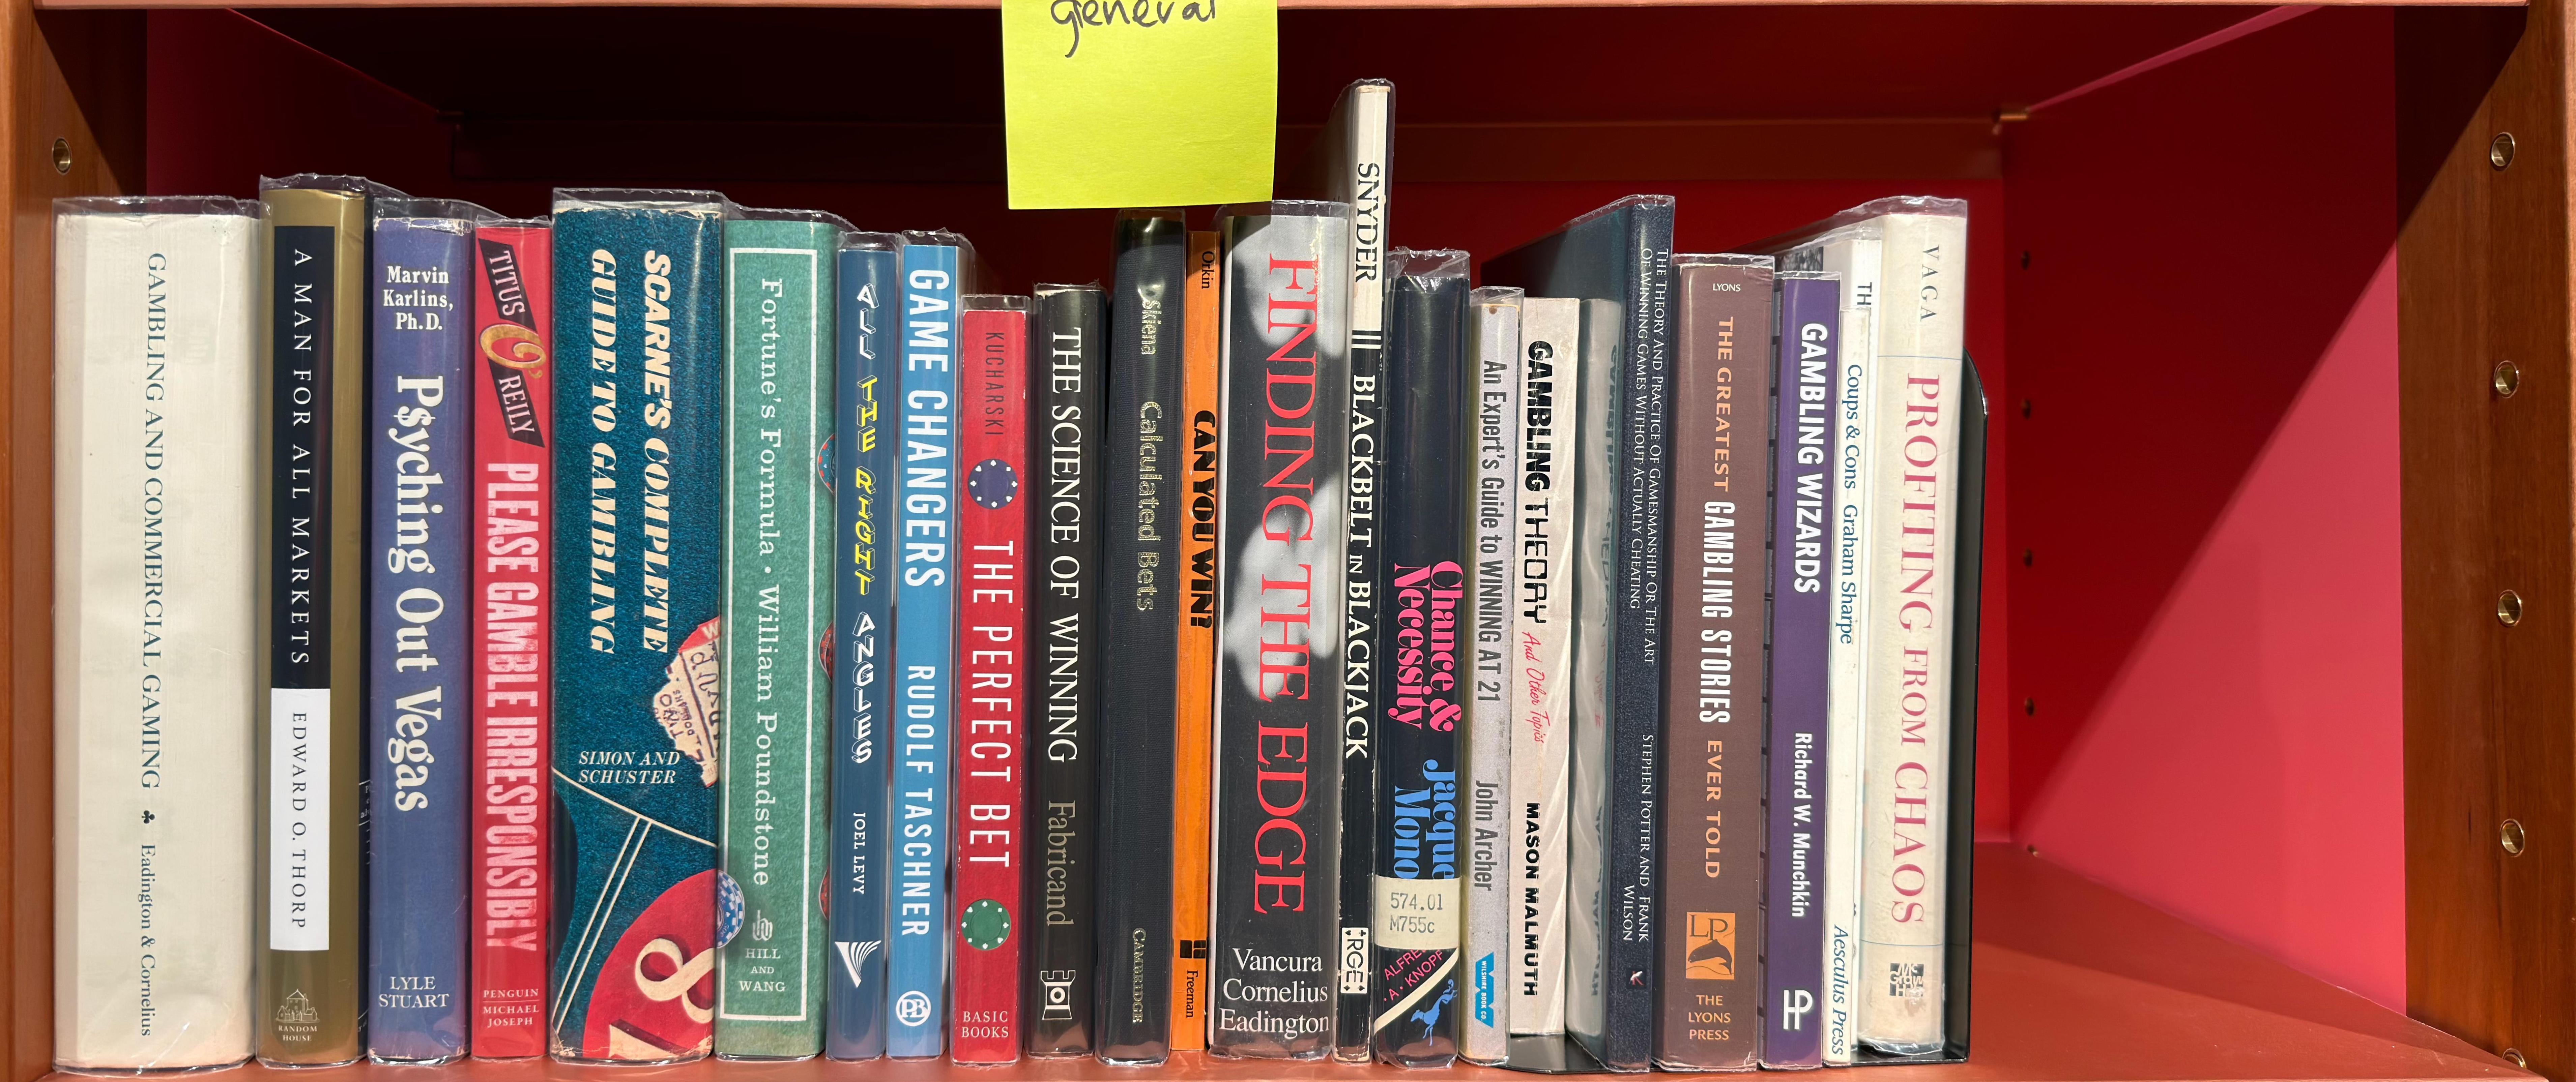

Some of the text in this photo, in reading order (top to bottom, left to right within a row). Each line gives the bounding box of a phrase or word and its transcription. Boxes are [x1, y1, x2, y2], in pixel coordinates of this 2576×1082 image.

[387, 266, 449, 283] Marvin
[1202, 250, 1214, 290] Orkin
[1355, 162, 1380, 283] SNYDER
[382, 290, 454, 311] Karlins,
[396, 313, 442, 330] Ph.D.
[489, 250, 525, 316] TITUS
[1141, 300, 1162, 355] Skiena
[1712, 283, 1741, 292] LYONS
[1920, 244, 1940, 322] VAGA
[905, 270, 950, 586] GAME CHANGERS
[984, 332, 1004, 436] KUCHARSKI
[1630, 248, 1652, 609] OF WINNING GAMES WITHOUT ACTUALLY CHEATING
[1842, 364, 1863, 489] Coups Cons
[291, 248, 312, 663] A MAN FOR ALL MARKETS
[590, 248, 616, 654] GUIDE TO GAMBLING
[643, 250, 672, 652] SCARNE'S COMPLETE
[1136, 402, 1162, 611] Calculated Bets
[1523, 340, 1553, 623] GAMBLING THEORY
[1644, 248, 1669, 664] THE THEORY AND PRACTICE OF GAMESMANSHIP OR THE ART
[1794, 323, 1828, 593] GAMBLING WIZARDS
[141, 252, 167, 789] GAMBLING AND COMMERCIAL GAMING
[851, 283, 878, 764] ALL THE RIGHT ANGLES
[1049, 327, 1081, 762] THE SCIENCE OF WINNING
[1190, 410, 1216, 628] CAN YOU WIN?
[1345, 375, 1375, 759] BLACKBELT BLACKJACK
[1477, 389, 1507, 702] Expert's Guide WINNING AT 21
[1836, 504, 1858, 644] Graham Sharpe
[396, 588, 444, 672] Out
[754, 277, 782, 885] Fortune's Formula William Poundstone
[1253, 252, 1319, 914] FINDING THE EDGE
[1430, 561, 1464, 693] Chance
[1699, 316, 1735, 879] THE GREATEST GAMBLING STORIES EVER TOLD
[1388, 563, 1430, 730] Necessity
[1522, 632, 1550, 743] And Other Topics
[1891, 374, 1939, 924] PROFITING FROM CHAOS
[387, 686, 442, 811] Vegas
[486, 463, 539, 951] PLEASE GAMBLE IRRESPONSIBLY
[579, 751, 680, 765] SIMON AND
[969, 540, 1013, 867] THE PERFECT BET
[292, 713, 307, 928] EDWARD THORP
[579, 769, 676, 783] SCHUSTER
[902, 664, 935, 936] RUDOLF TASCHNER
[1791, 732, 1812, 918] Richard Munchkin
[853, 812, 866, 895] JOEL LEVY
[1046, 800, 1075, 926] Fabricand
[1474, 780, 1498, 892] John Archer
[1639, 734, 1653, 942] STEPHEN POTTER AND FRANK
[138, 844, 155, 1035] Eadington Cornelius
[745, 948, 781, 959] HILL
[1390, 915, 1435, 933] M755c
[1391, 893, 1443, 910] 574.01
[1524, 802, 1539, 997] MASON MALMUTH
[1623, 885, 1634, 941] WILSON
[378, 994, 450, 1008] STUART
[389, 976, 436, 990] LYLE
[483, 988, 539, 998] PENGUIN
[483, 1005, 539, 1015] MICHAEL
[739, 981, 786, 991] WANG
[1132, 928, 1146, 1023] CAMBRIDGE
[1186, 970, 1198, 1018] Freeman
[1223, 978, 1328, 1003] Cornelius
[1234, 948, 1323, 972] Vancura
[1696, 995, 1723, 1005] THE
[1832, 924, 1849, 1055] Aesculus Press
[278, 1025, 318, 1033] RANDOM
[488, 1016, 533, 1026] JOSEPH
[961, 1026, 1008, 1038] BOOKS
[963, 1012, 1008, 1022] BASIC
[1218, 1007, 1330, 1039] Eadington
[1688, 1012, 1731, 1023] LYONS
[1689, 1029, 1729, 1040] PRESS
